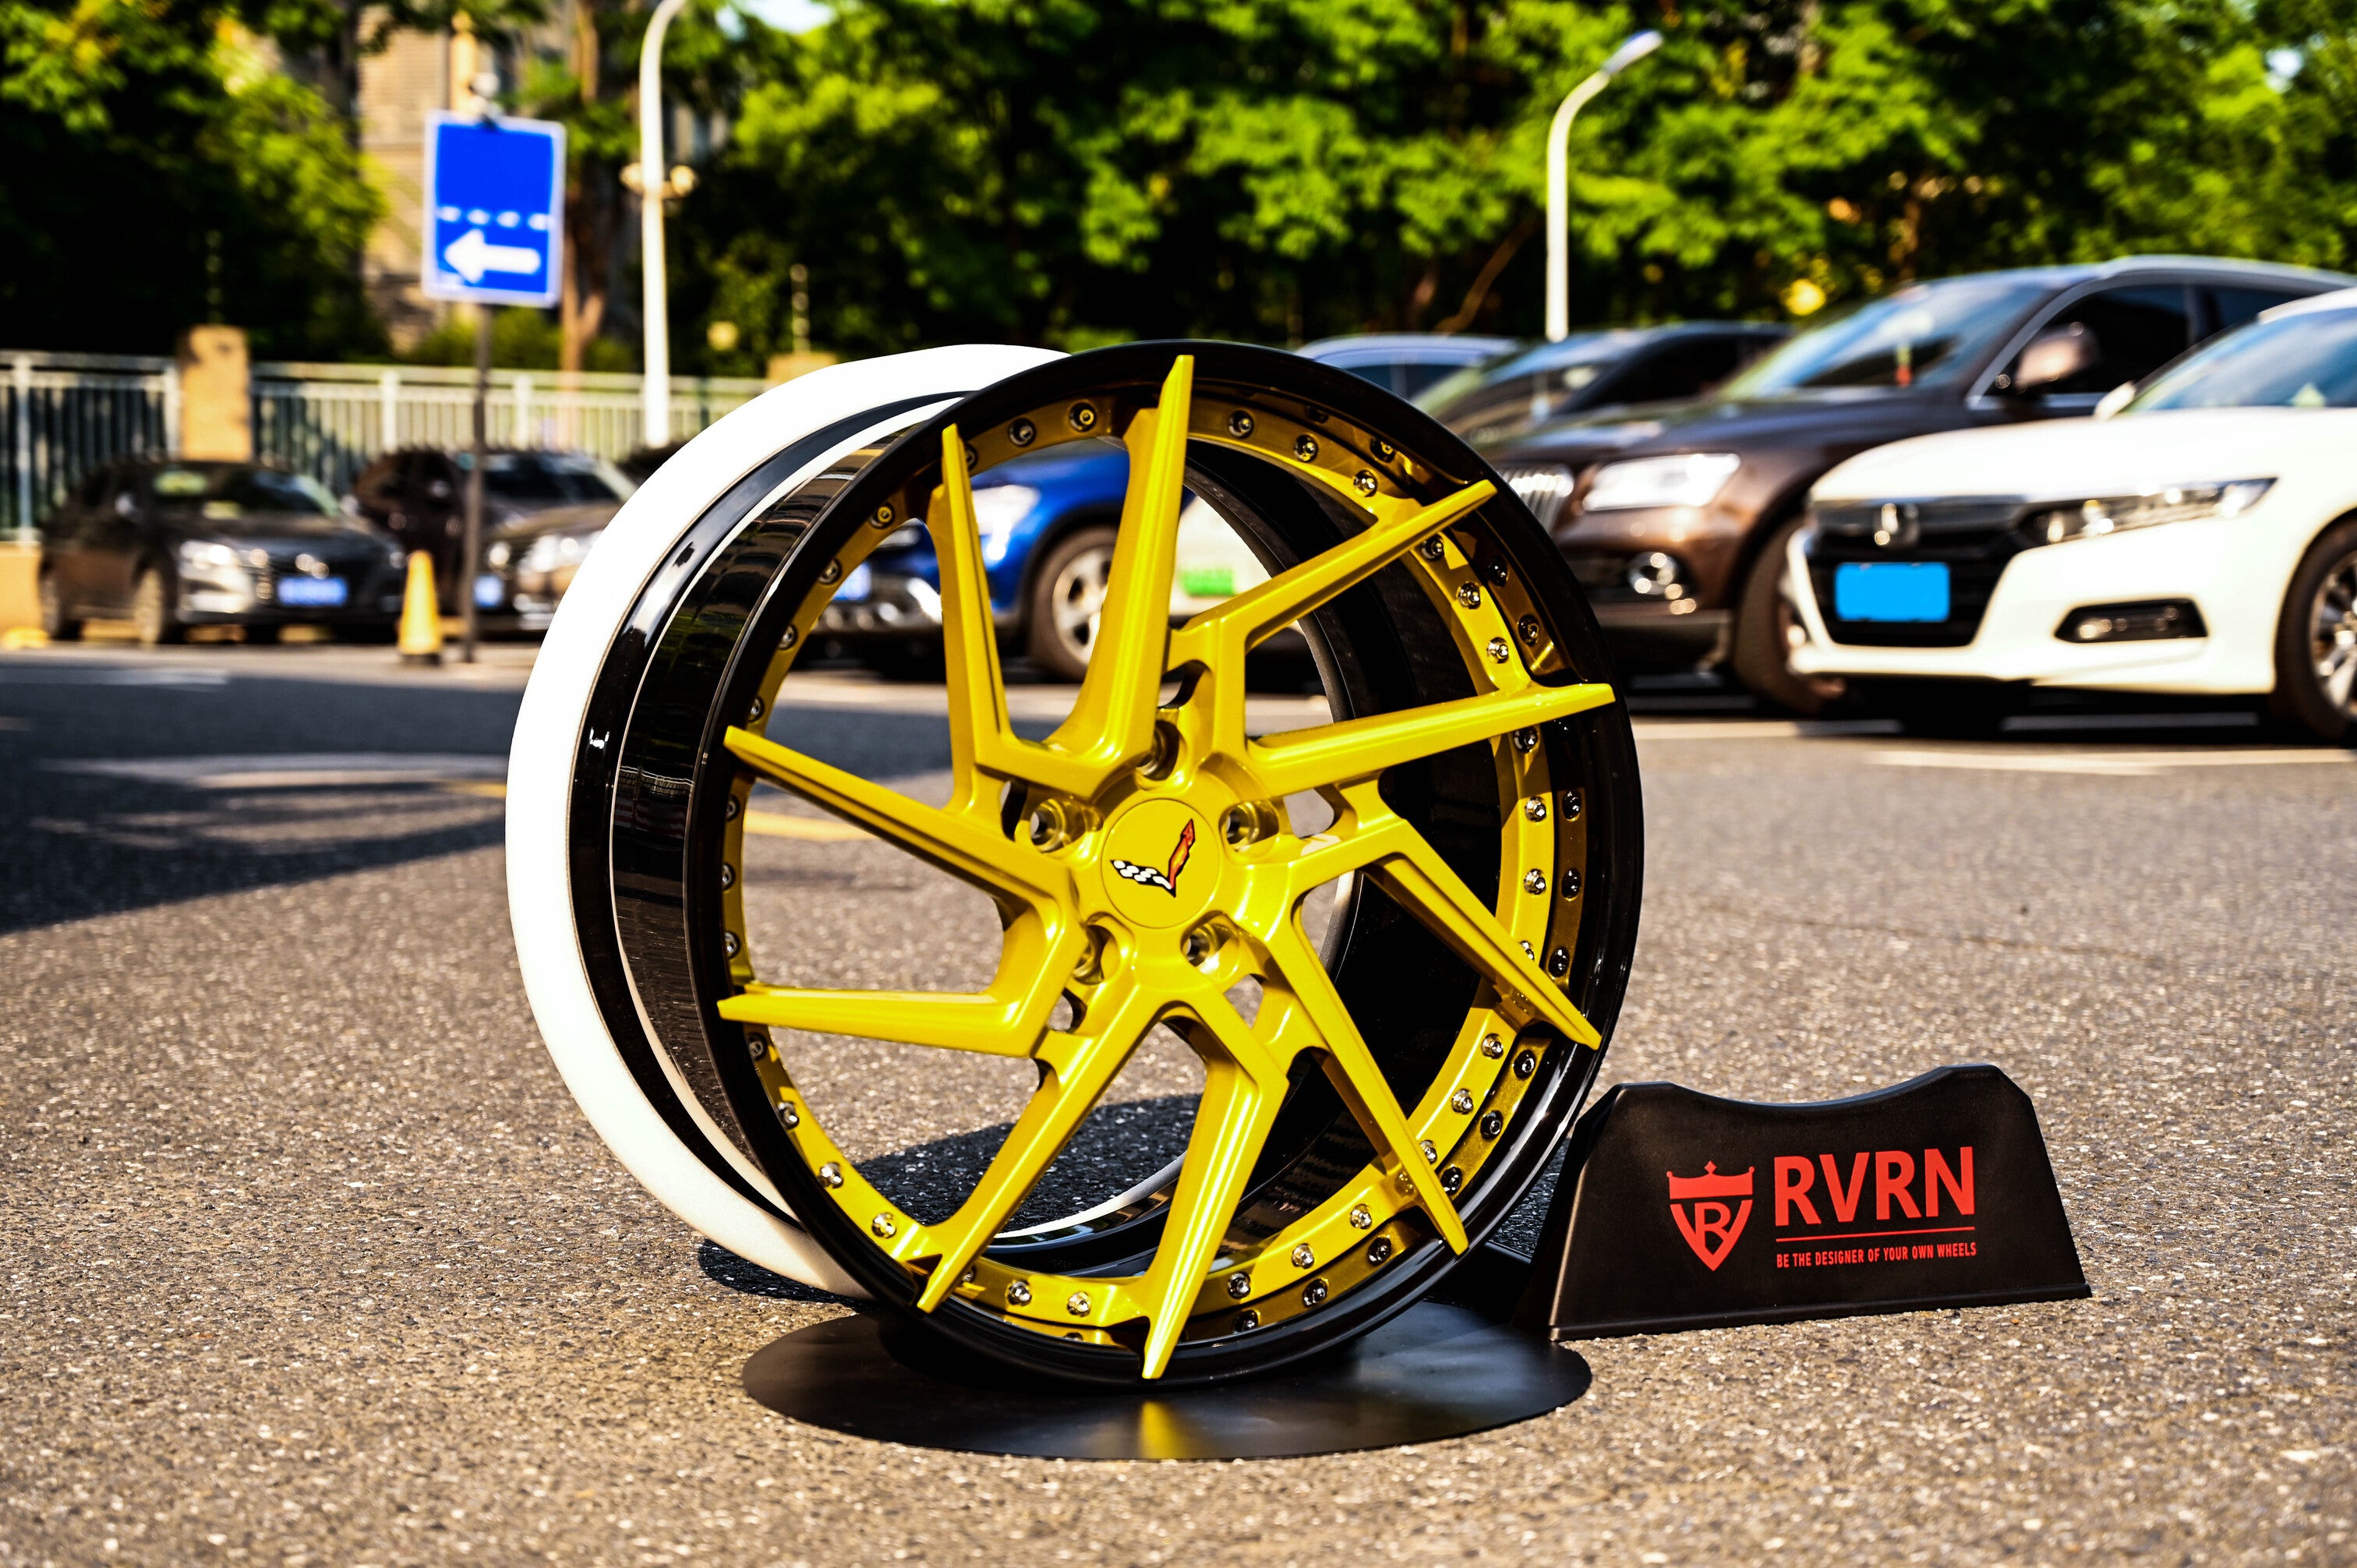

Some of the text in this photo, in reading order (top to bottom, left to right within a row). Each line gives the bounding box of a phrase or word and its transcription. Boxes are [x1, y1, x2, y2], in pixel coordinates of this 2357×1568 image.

[1774, 1146, 1976, 1227] RVRN
[1776, 1241, 1977, 1269] BE THE DESIGNER OF YOUR OWN WHEELS
